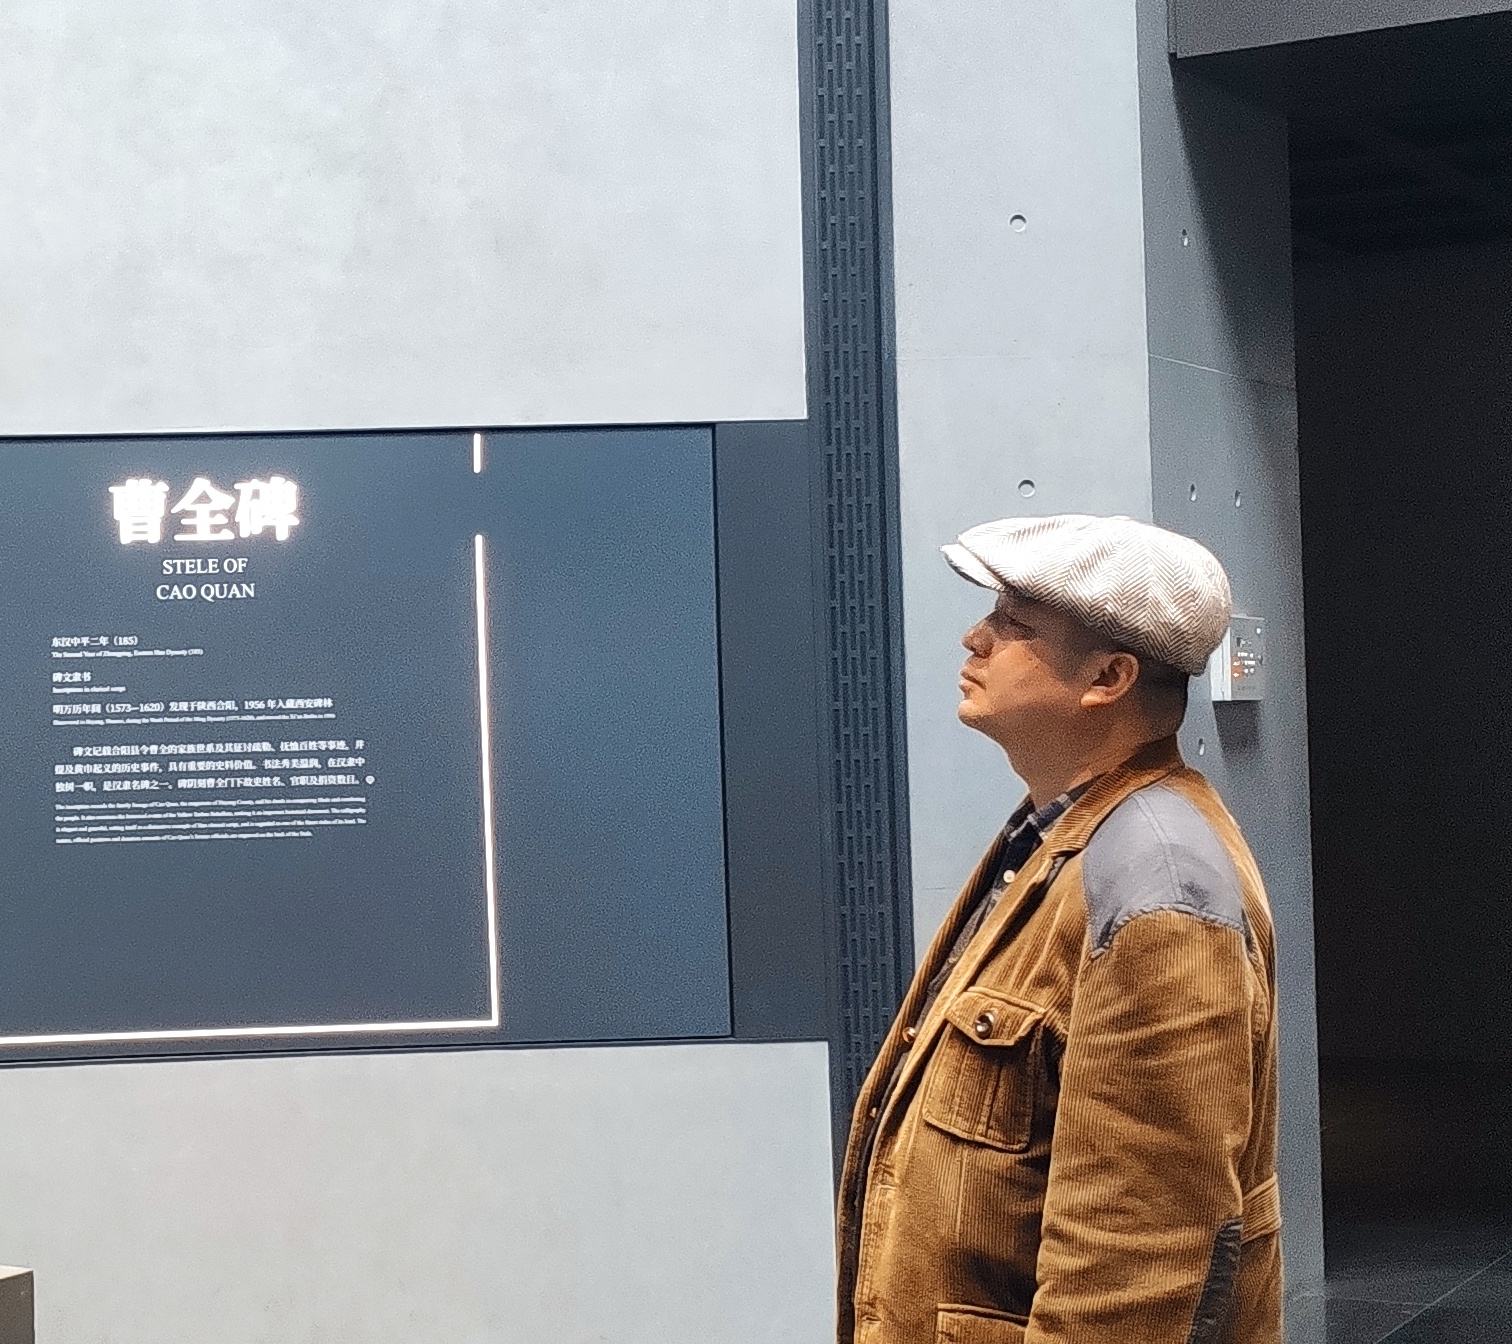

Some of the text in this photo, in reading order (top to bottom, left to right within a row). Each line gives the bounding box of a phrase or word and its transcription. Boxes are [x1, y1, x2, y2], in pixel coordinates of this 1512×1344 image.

[108, 476, 300, 544] 曹全碑
[162, 557, 248, 575] STELE OF
[156, 583, 255, 602] CAO QUAN
